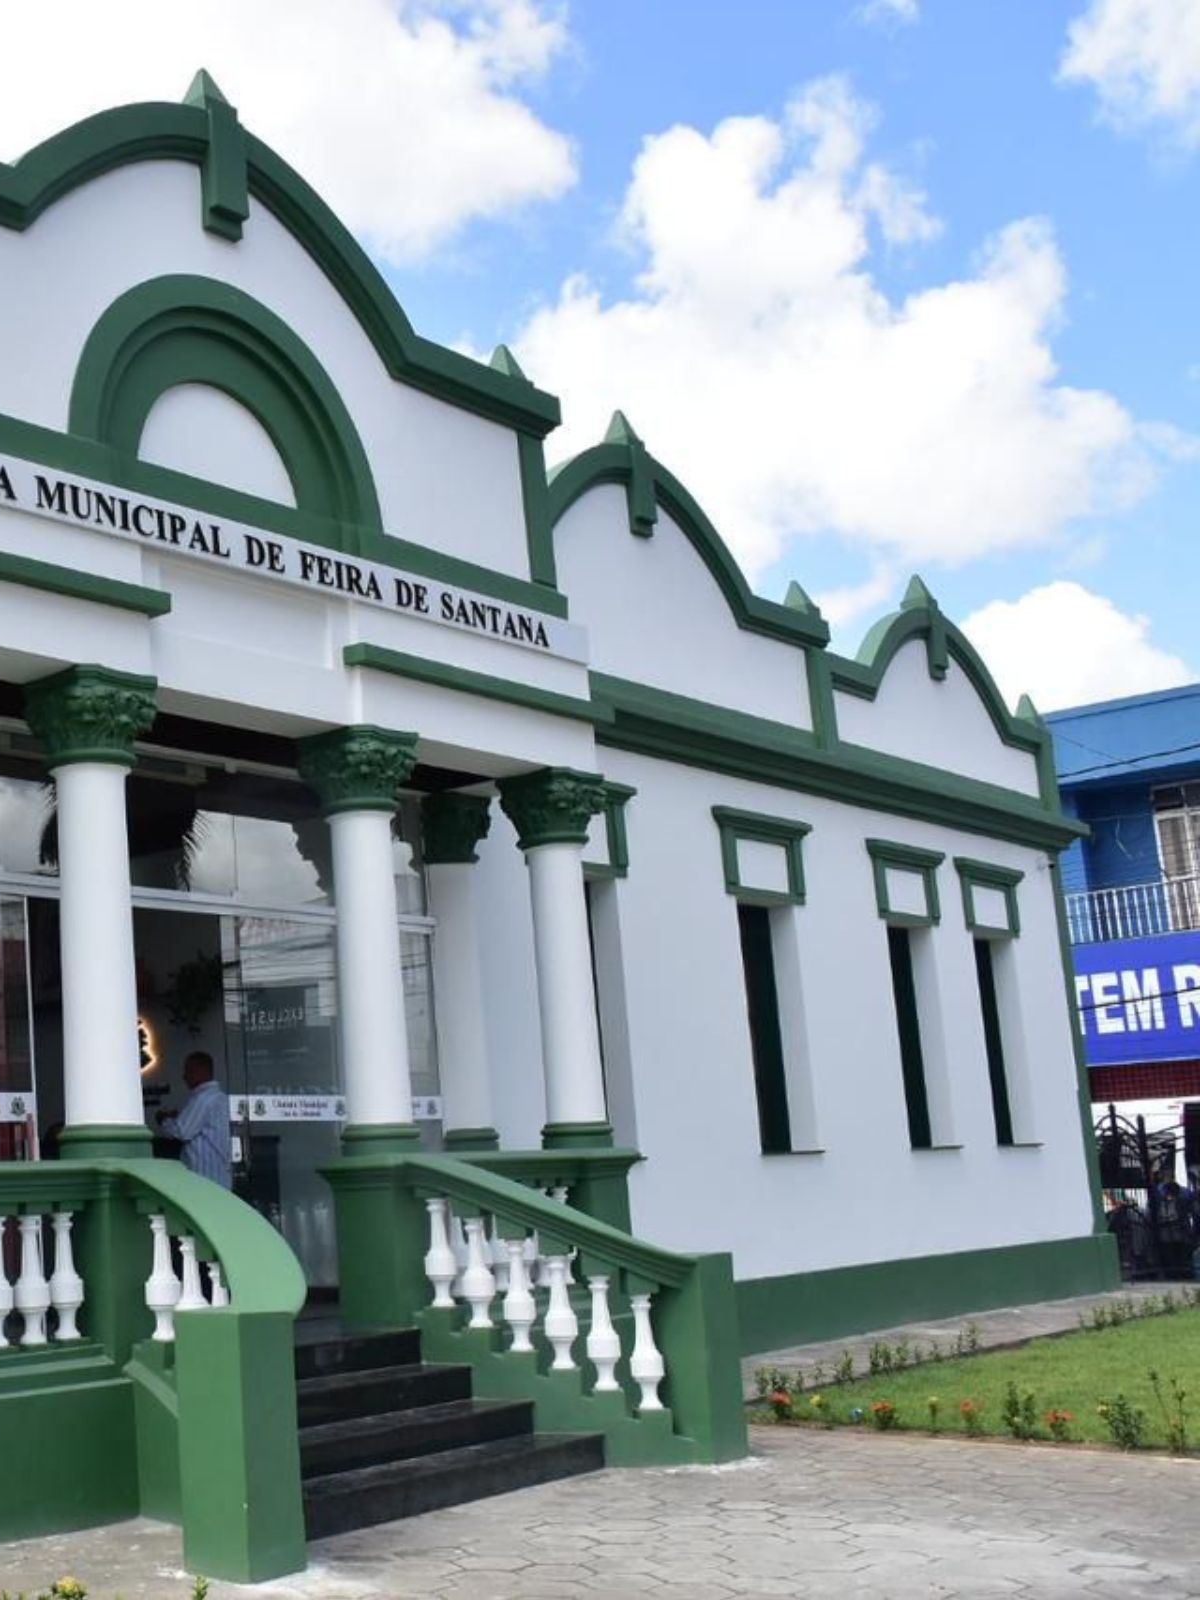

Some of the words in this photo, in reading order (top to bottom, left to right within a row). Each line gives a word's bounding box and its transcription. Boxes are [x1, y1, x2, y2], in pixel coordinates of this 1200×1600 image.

[34, 474, 230, 559] MUNICIPAL
[243, 533, 286, 575] DE
[297, 549, 383, 601] FEIRA
[393, 577, 430, 614] DE
[440, 592, 550, 649] SANTANA
